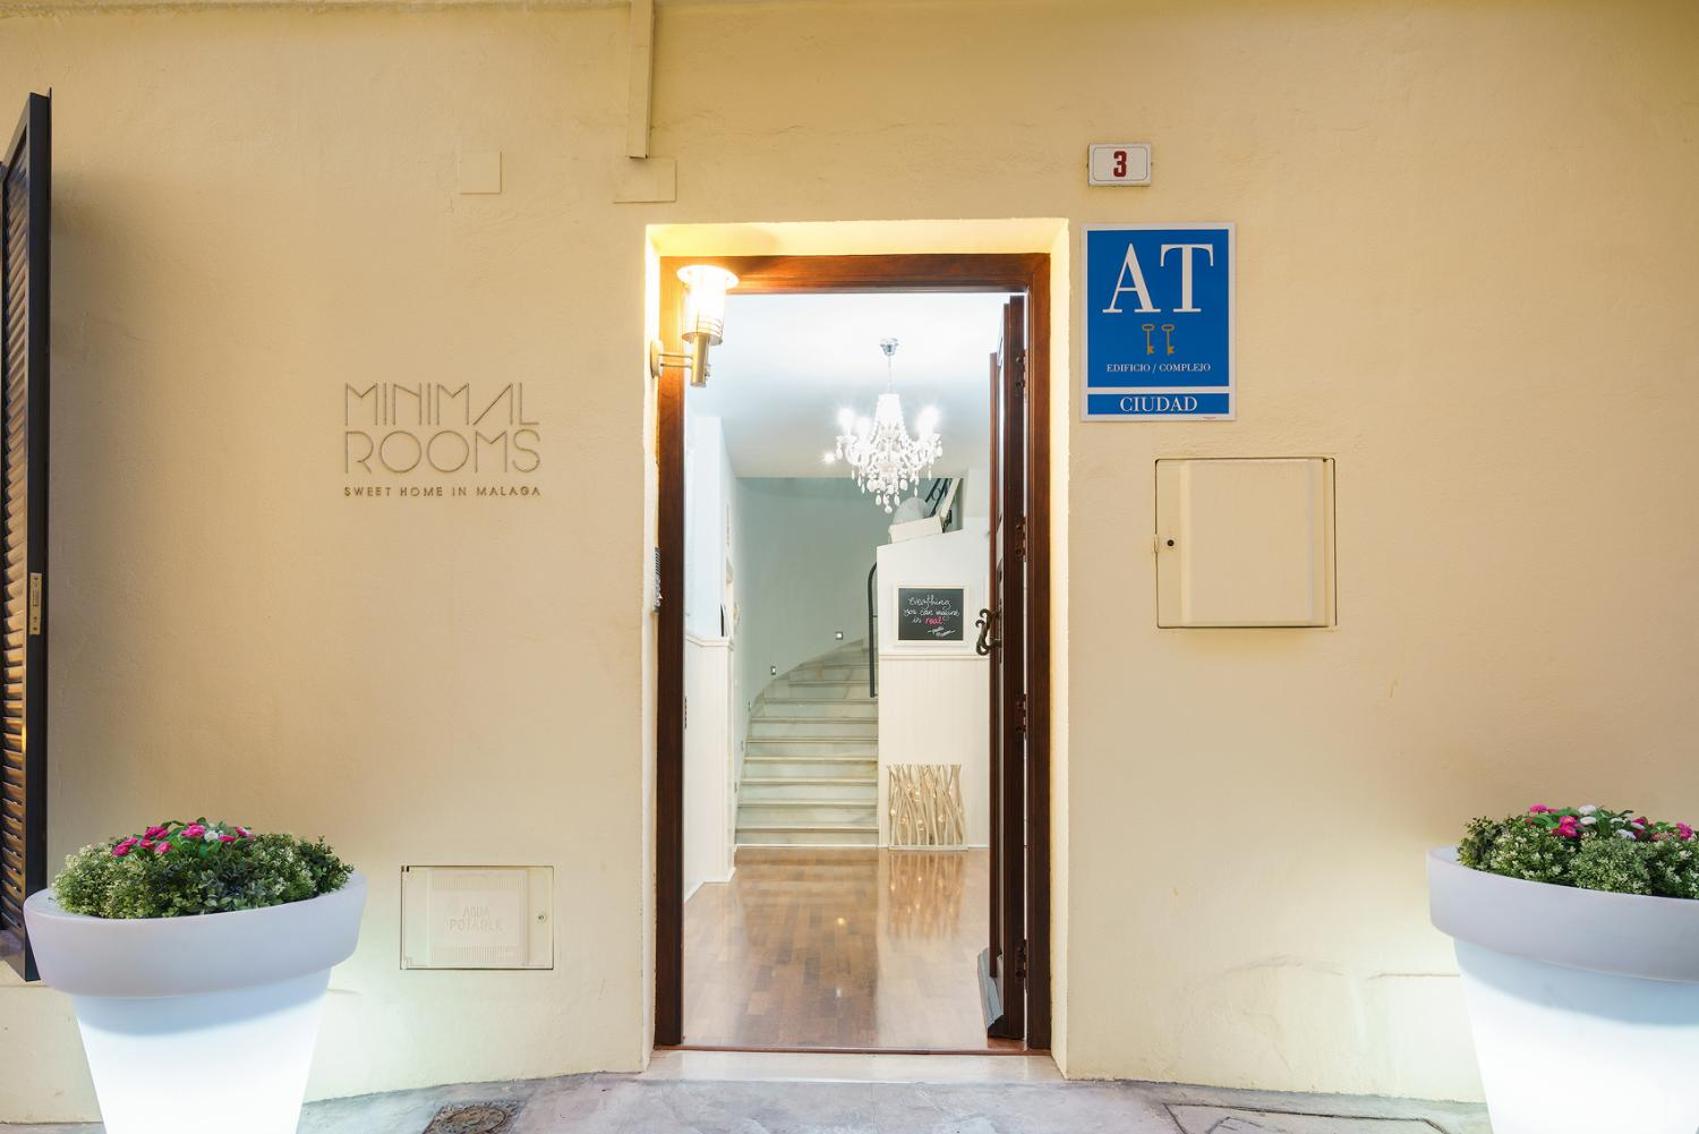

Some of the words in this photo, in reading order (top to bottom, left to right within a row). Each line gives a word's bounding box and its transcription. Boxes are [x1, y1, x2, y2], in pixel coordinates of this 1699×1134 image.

[1113, 151, 1128, 177] 3
[1102, 243, 1214, 313] AT
[1106, 363, 1151, 373] EDIFICIO
[1159, 362, 1212, 373] COMPLEJO
[345, 382, 540, 426] MINIMAL
[1119, 396, 1198, 412] CIUDAD
[345, 429, 541, 474] ROOMS
[344, 486, 392, 497] SWEET
[399, 486, 443, 497] HOME
[452, 486, 467, 497] IN
[476, 486, 541, 497] MALAGA
